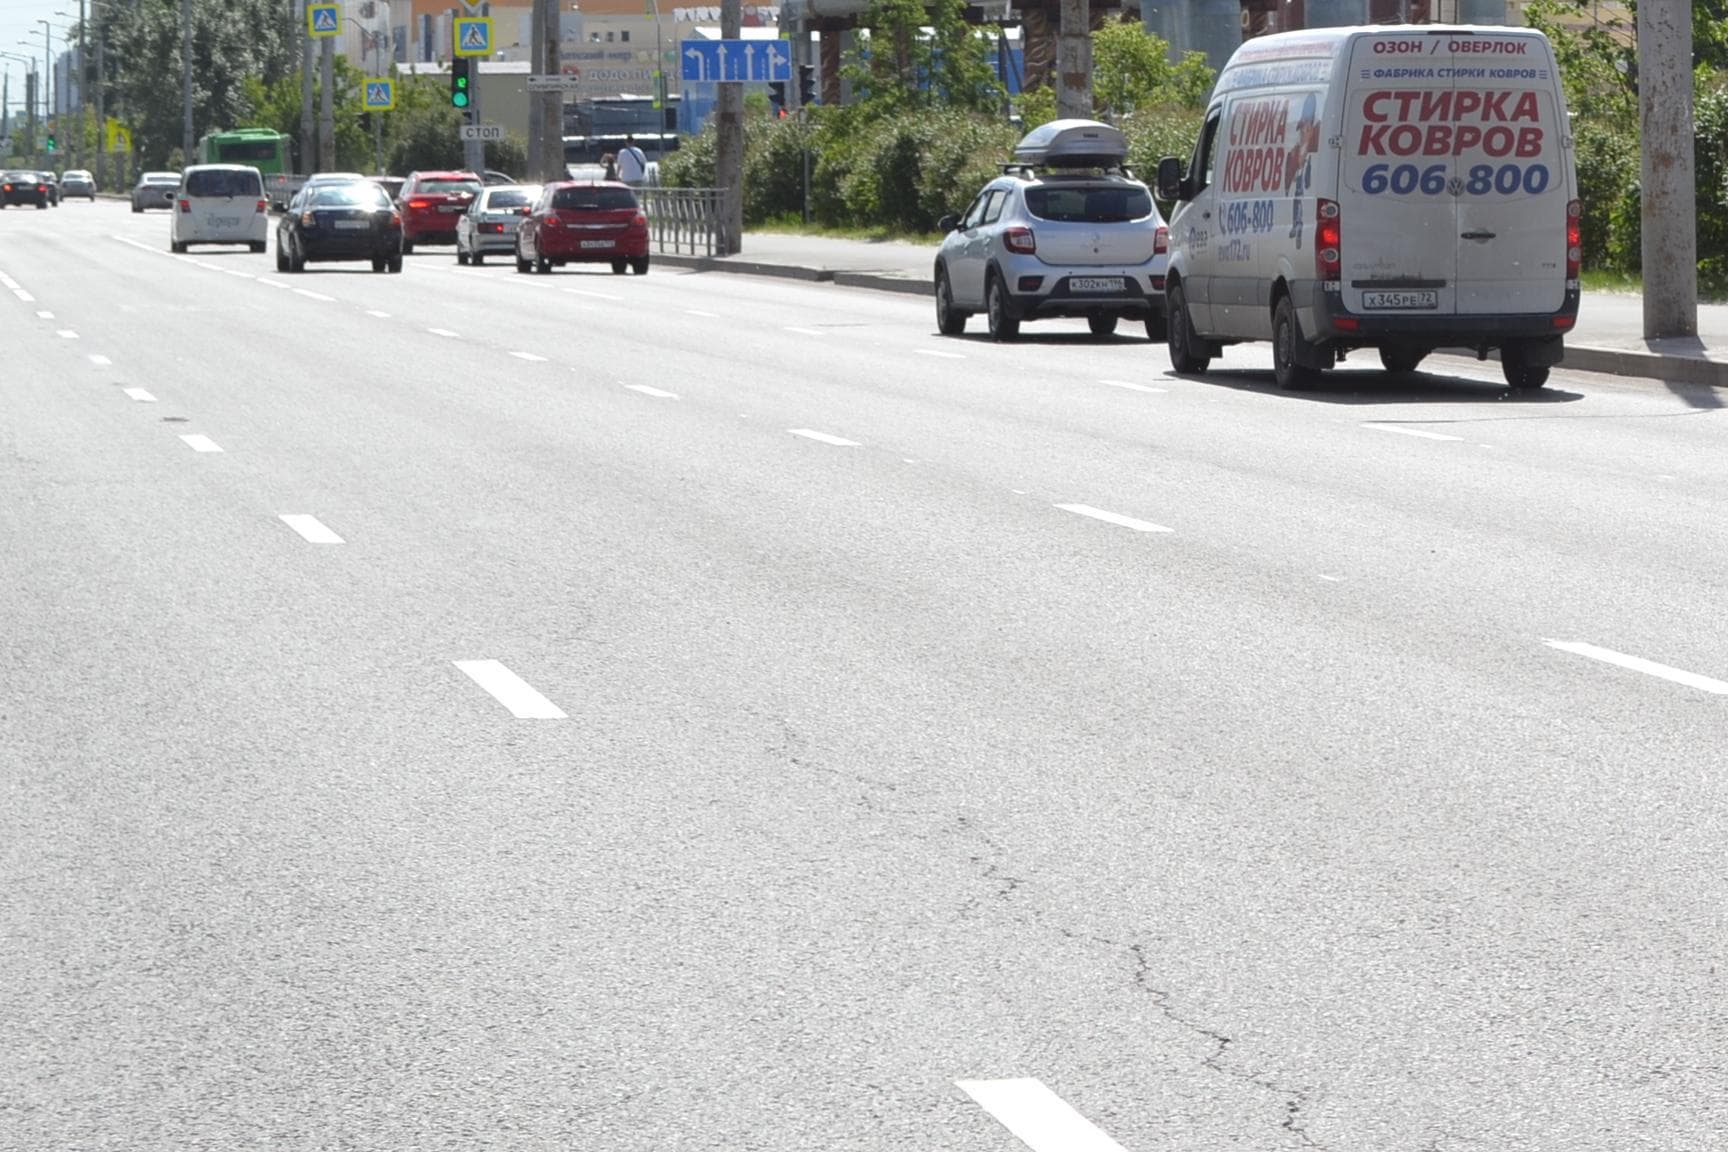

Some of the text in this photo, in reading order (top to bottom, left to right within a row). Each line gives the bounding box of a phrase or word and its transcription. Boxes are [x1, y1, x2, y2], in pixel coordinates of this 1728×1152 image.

[1373, 41, 1423, 54] ОЗОН
[1447, 41, 1528, 55] ОВЕРЛОК
[1373, 68, 1537, 79] ФАБРИКА СТИРКИ КОВРОВ
[1230, 100, 1290, 146] СТИРКА
[1362, 90, 1540, 123] СТИРКА
[1357, 124, 1544, 158] КОВРОВ
[1223, 146, 1285, 193] КОВРОВ
[1361, 163, 1550, 195] 606 800
